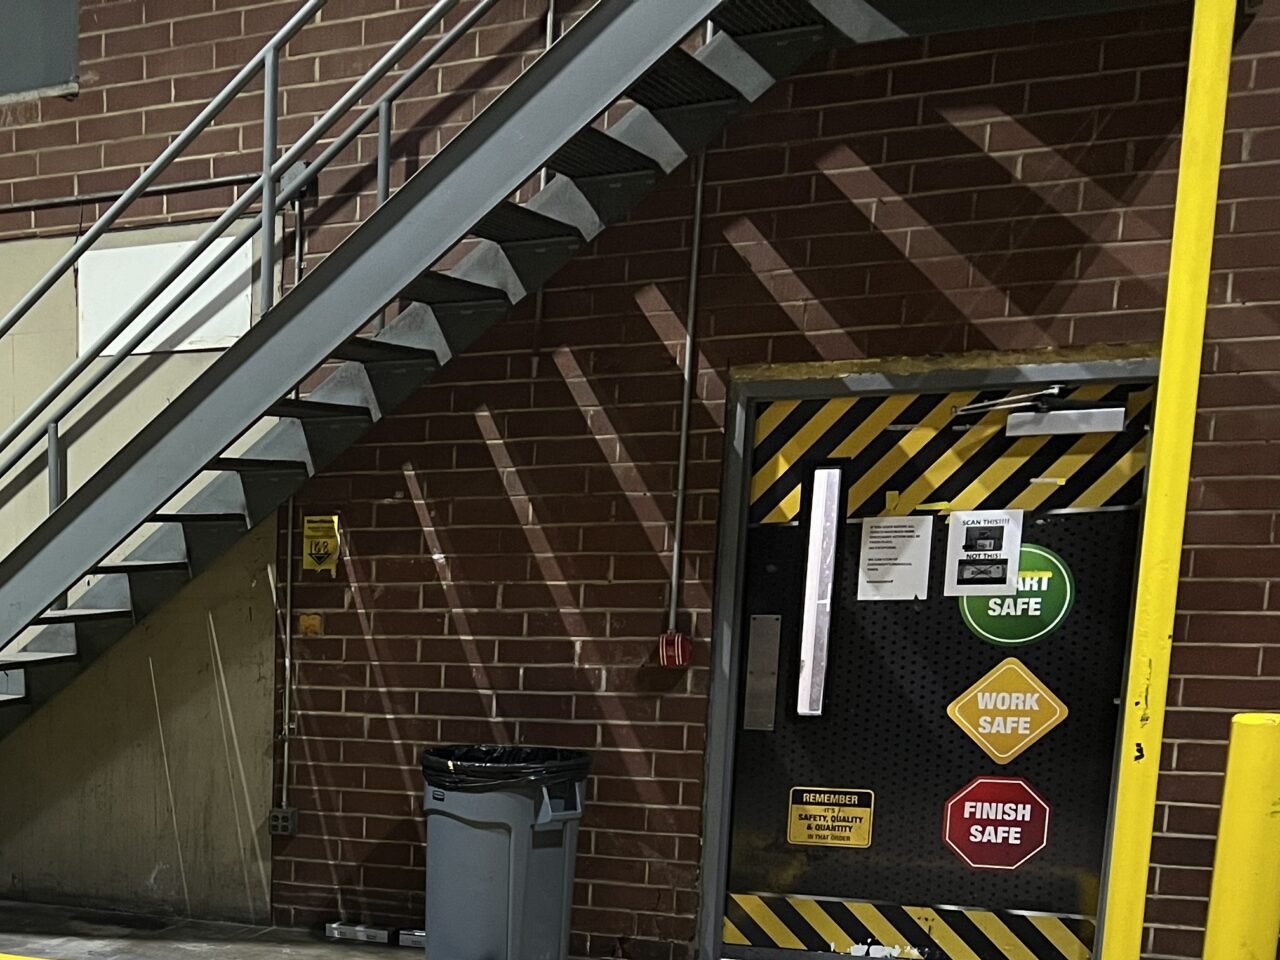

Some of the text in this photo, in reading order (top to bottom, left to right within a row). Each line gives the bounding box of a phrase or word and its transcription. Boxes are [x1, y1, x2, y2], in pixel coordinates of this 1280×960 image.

[987, 597, 1042, 616] SAFE
[977, 692, 1040, 711] WORK
[978, 716, 1031, 735] SAFE
[802, 793, 859, 805] REMEMBER
[798, 813, 864, 824] SAFETY, QUALITY
[963, 801, 1032, 821] FINISH
[806, 823, 854, 833] & QUANTITY
[969, 824, 1022, 844] SAFE
